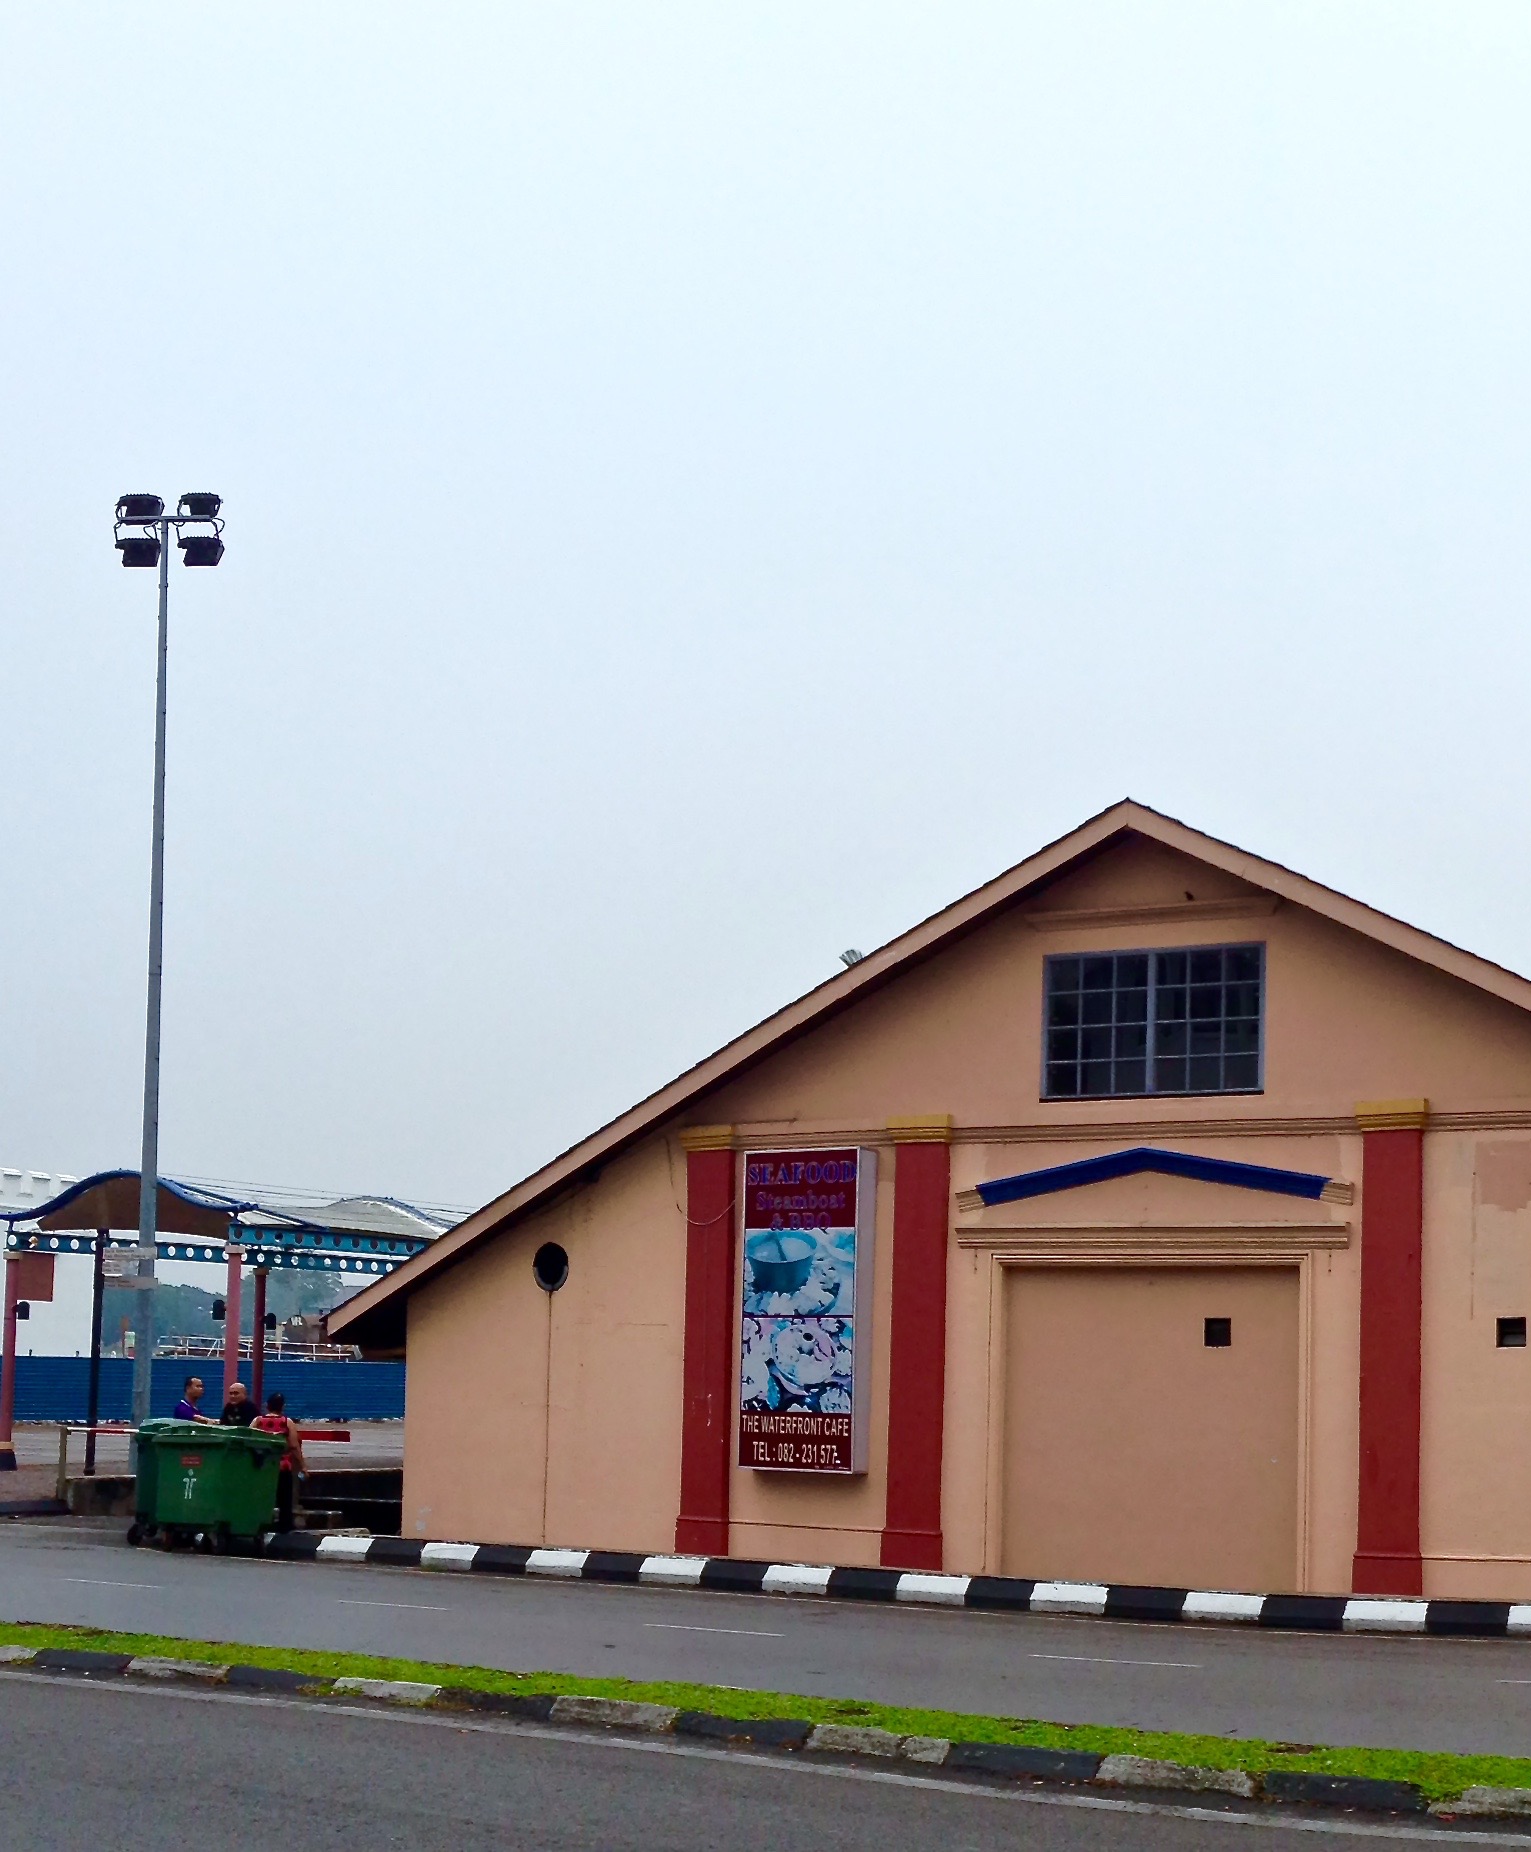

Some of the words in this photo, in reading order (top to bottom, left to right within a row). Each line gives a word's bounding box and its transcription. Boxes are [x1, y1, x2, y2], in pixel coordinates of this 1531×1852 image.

[747, 1160, 857, 1186] SEAFOOD
[756, 1189, 846, 1211] Steamboat
[788, 1211, 830, 1234] BBQ
[742, 1414, 759, 1433] THE
[760, 1416, 822, 1436] WATERFRONT
[824, 1418, 849, 1437] CAFE
[777, 1443, 794, 1462] 082
[801, 1444, 817, 1463] 231
